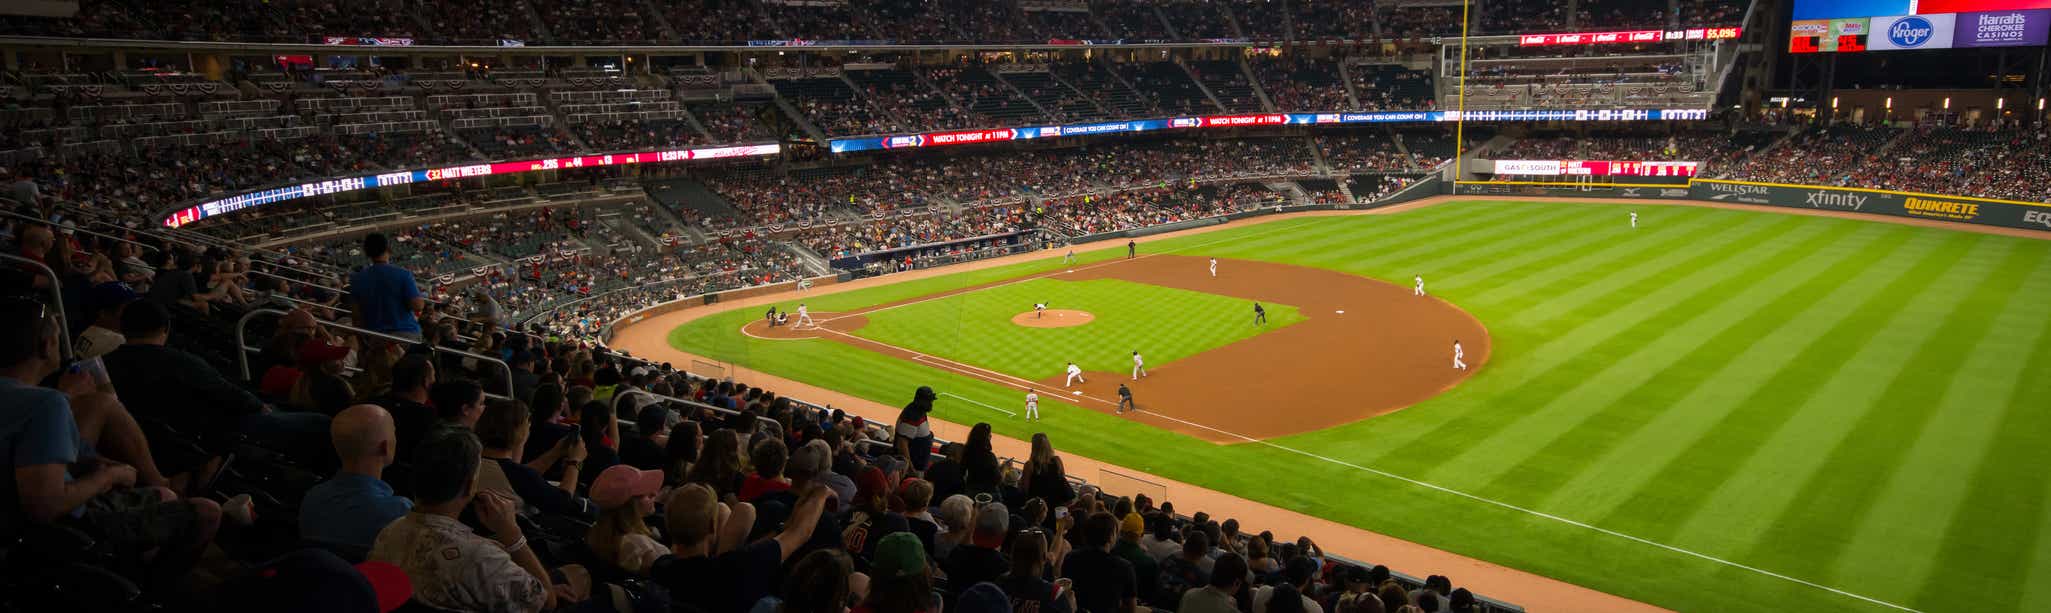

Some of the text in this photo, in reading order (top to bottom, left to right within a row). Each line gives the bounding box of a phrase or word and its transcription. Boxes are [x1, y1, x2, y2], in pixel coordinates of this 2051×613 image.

[1978, 13, 2024, 26] Harrah's
[1707, 28, 1736, 39] $5,096
[1892, 22, 1930, 44] Kroger
[1978, 24, 2024, 32] CHEROKEE
[933, 133, 955, 143] WATCH
[956, 132, 982, 142] TONIGHT
[441, 167, 460, 178] MATT
[461, 164, 492, 177] WIETERS
[678, 150, 688, 160] PM
[1710, 183, 1768, 195] WELLSTAR
[1806, 190, 1868, 210] xfinity
[1904, 197, 1979, 215] QUIKRETE
